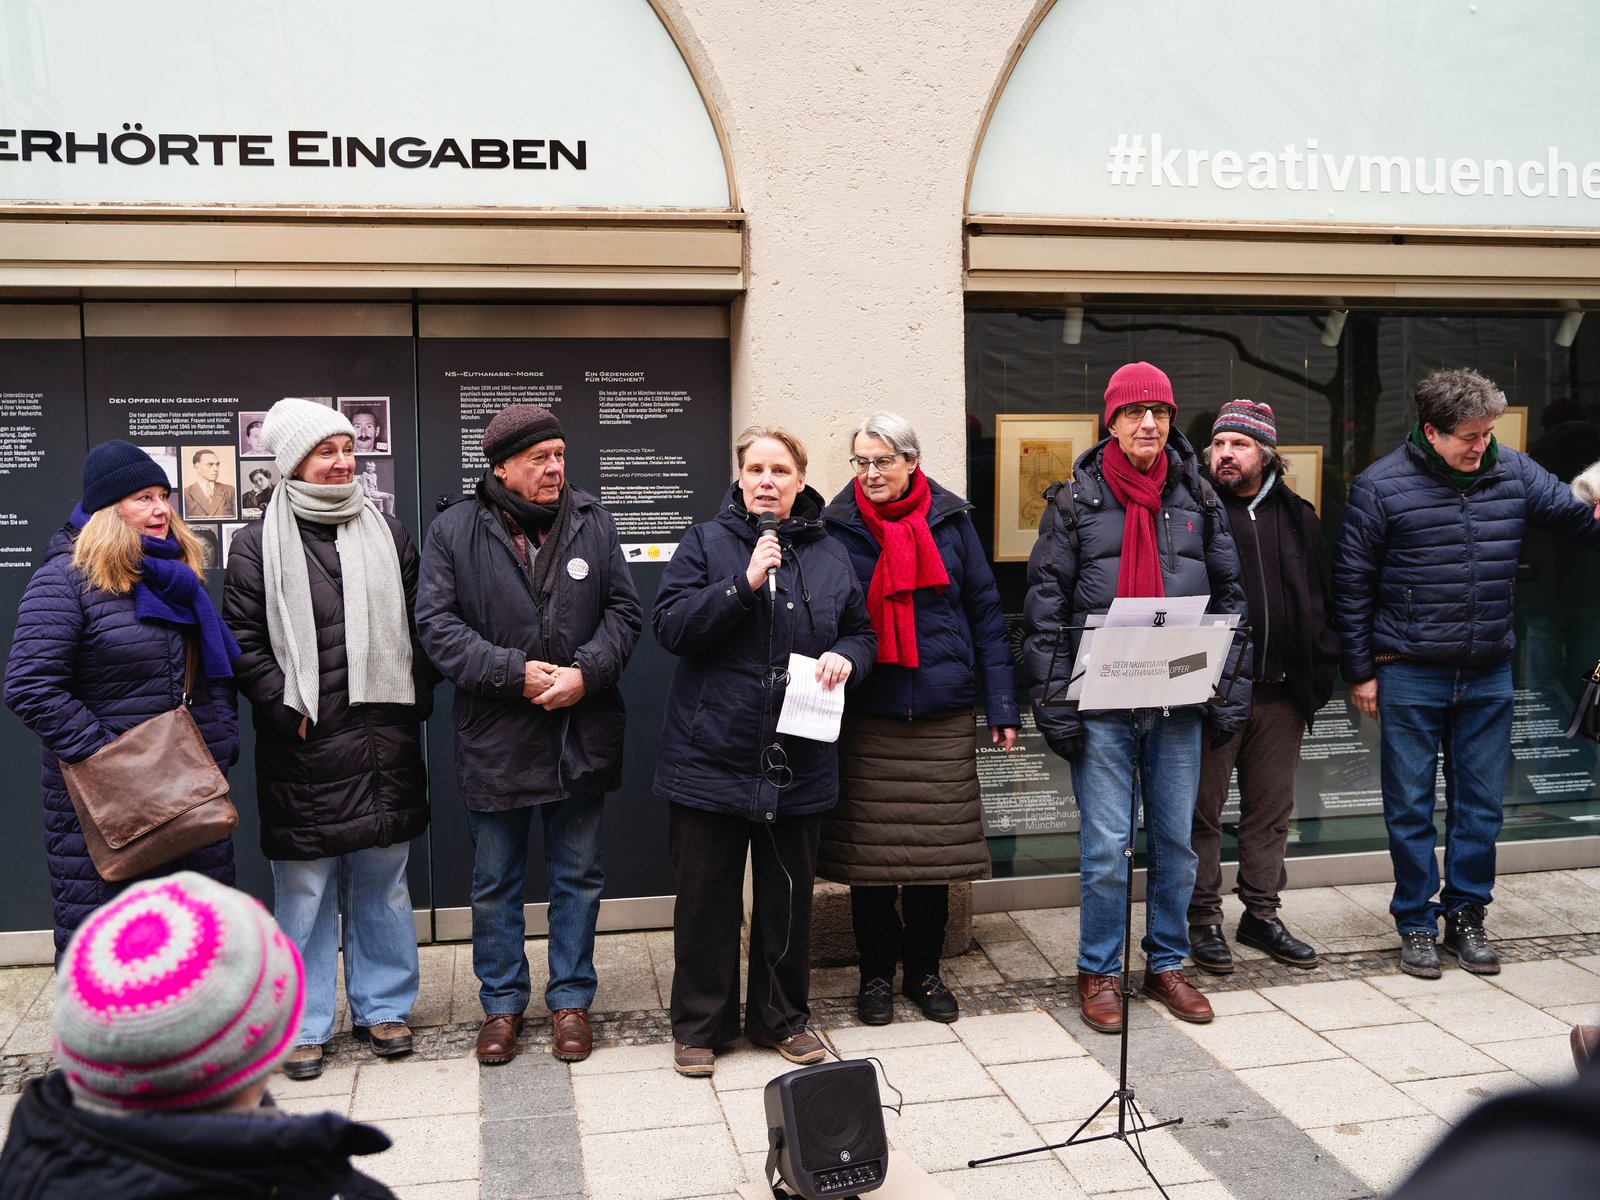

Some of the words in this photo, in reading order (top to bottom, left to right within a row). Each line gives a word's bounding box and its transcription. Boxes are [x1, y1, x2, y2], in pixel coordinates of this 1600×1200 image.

[288, 130, 586, 170] EINGABEN
[1106, 133, 1600, 200] #kreativmuenche
[1113, 660, 1168, 669] GEDENKINITIATIVE
[1169, 665, 1189, 674] OPFER
[1025, 821, 1066, 830] München
